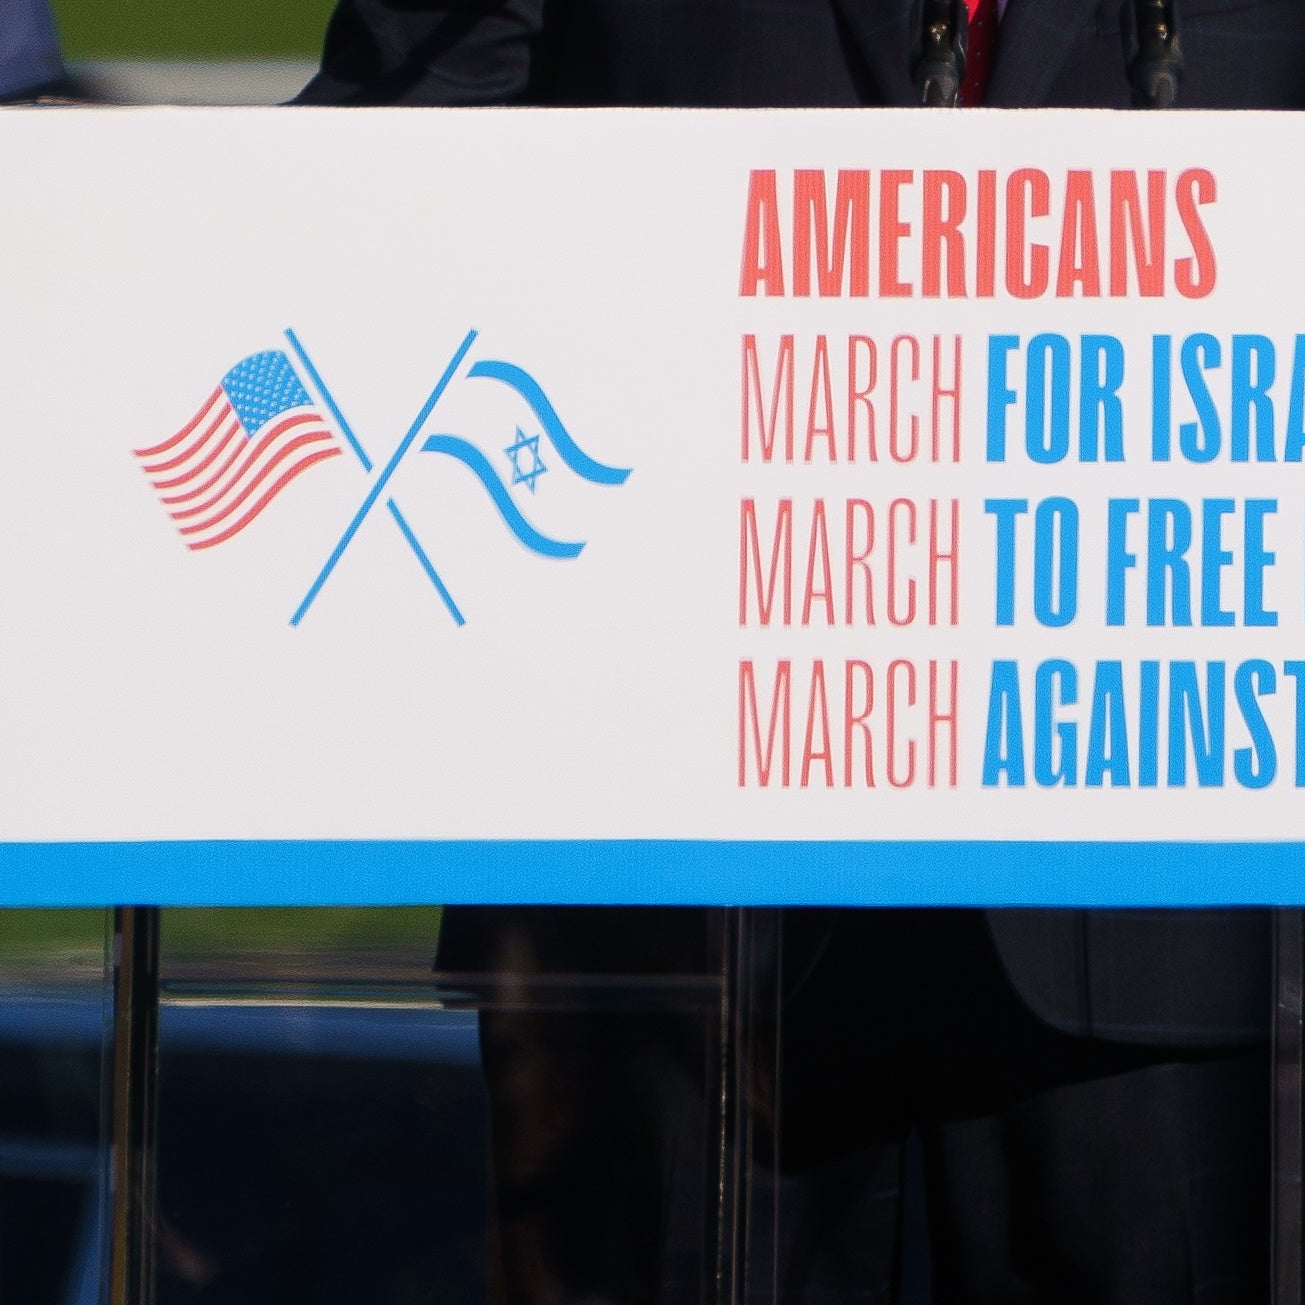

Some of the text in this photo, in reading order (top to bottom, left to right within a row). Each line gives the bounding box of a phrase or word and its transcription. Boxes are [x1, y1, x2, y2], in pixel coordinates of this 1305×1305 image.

[740, 168, 1215, 298] AMERICANS
[740, 335, 961, 462] MARCH
[986, 333, 1124, 463] FOR
[740, 498, 959, 625] MARCH
[984, 497, 1078, 627] TO
[1106, 497, 1277, 626] FREE
[739, 659, 958, 787] MARCH
